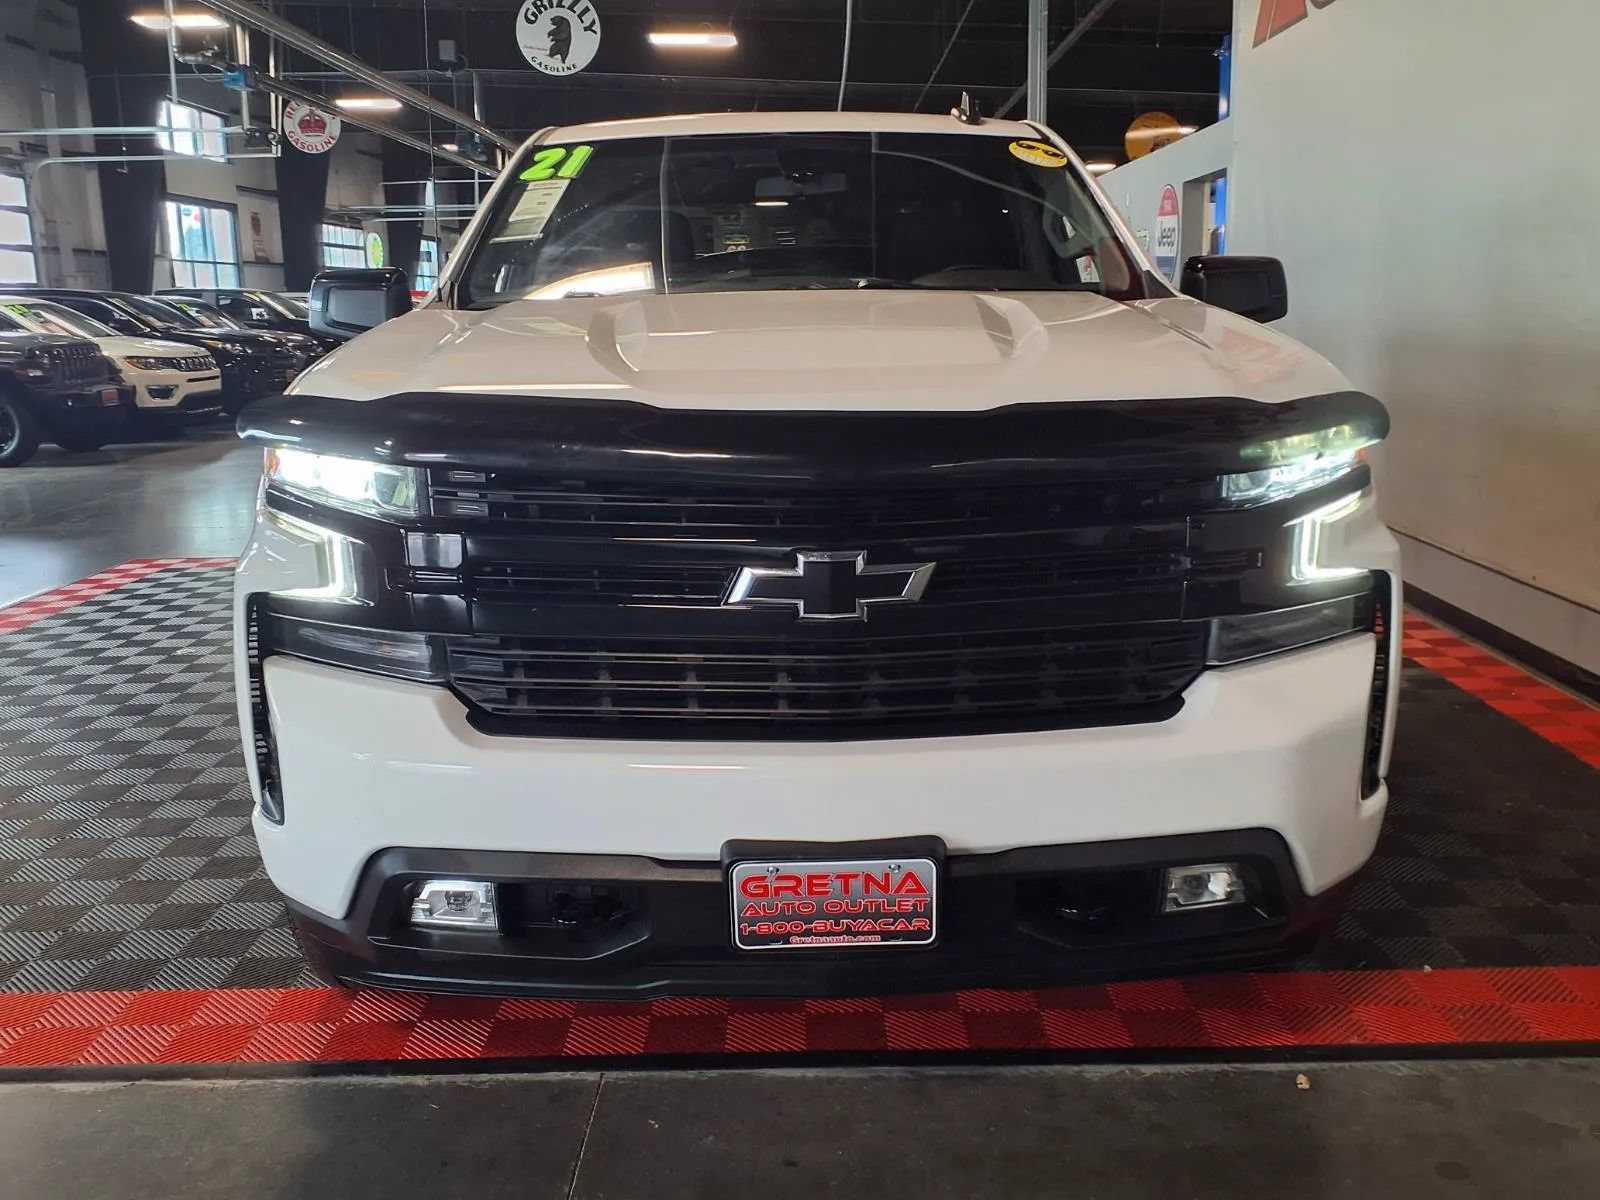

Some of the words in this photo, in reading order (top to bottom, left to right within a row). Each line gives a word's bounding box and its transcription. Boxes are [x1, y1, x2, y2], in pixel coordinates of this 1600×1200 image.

[523, 0, 598, 35] GRIZZLY
[531, 56, 577, 72] GASOLINE
[288, 130, 336, 152] GASOLINE
[519, 145, 593, 180] 21
[1157, 221, 1175, 254] Jeep
[740, 872, 929, 898] GRETNA
[740, 900, 817, 917] AUTO
[824, 898, 930, 914] OUTLET
[740, 918, 930, 935] 1-800-BUYACAR
